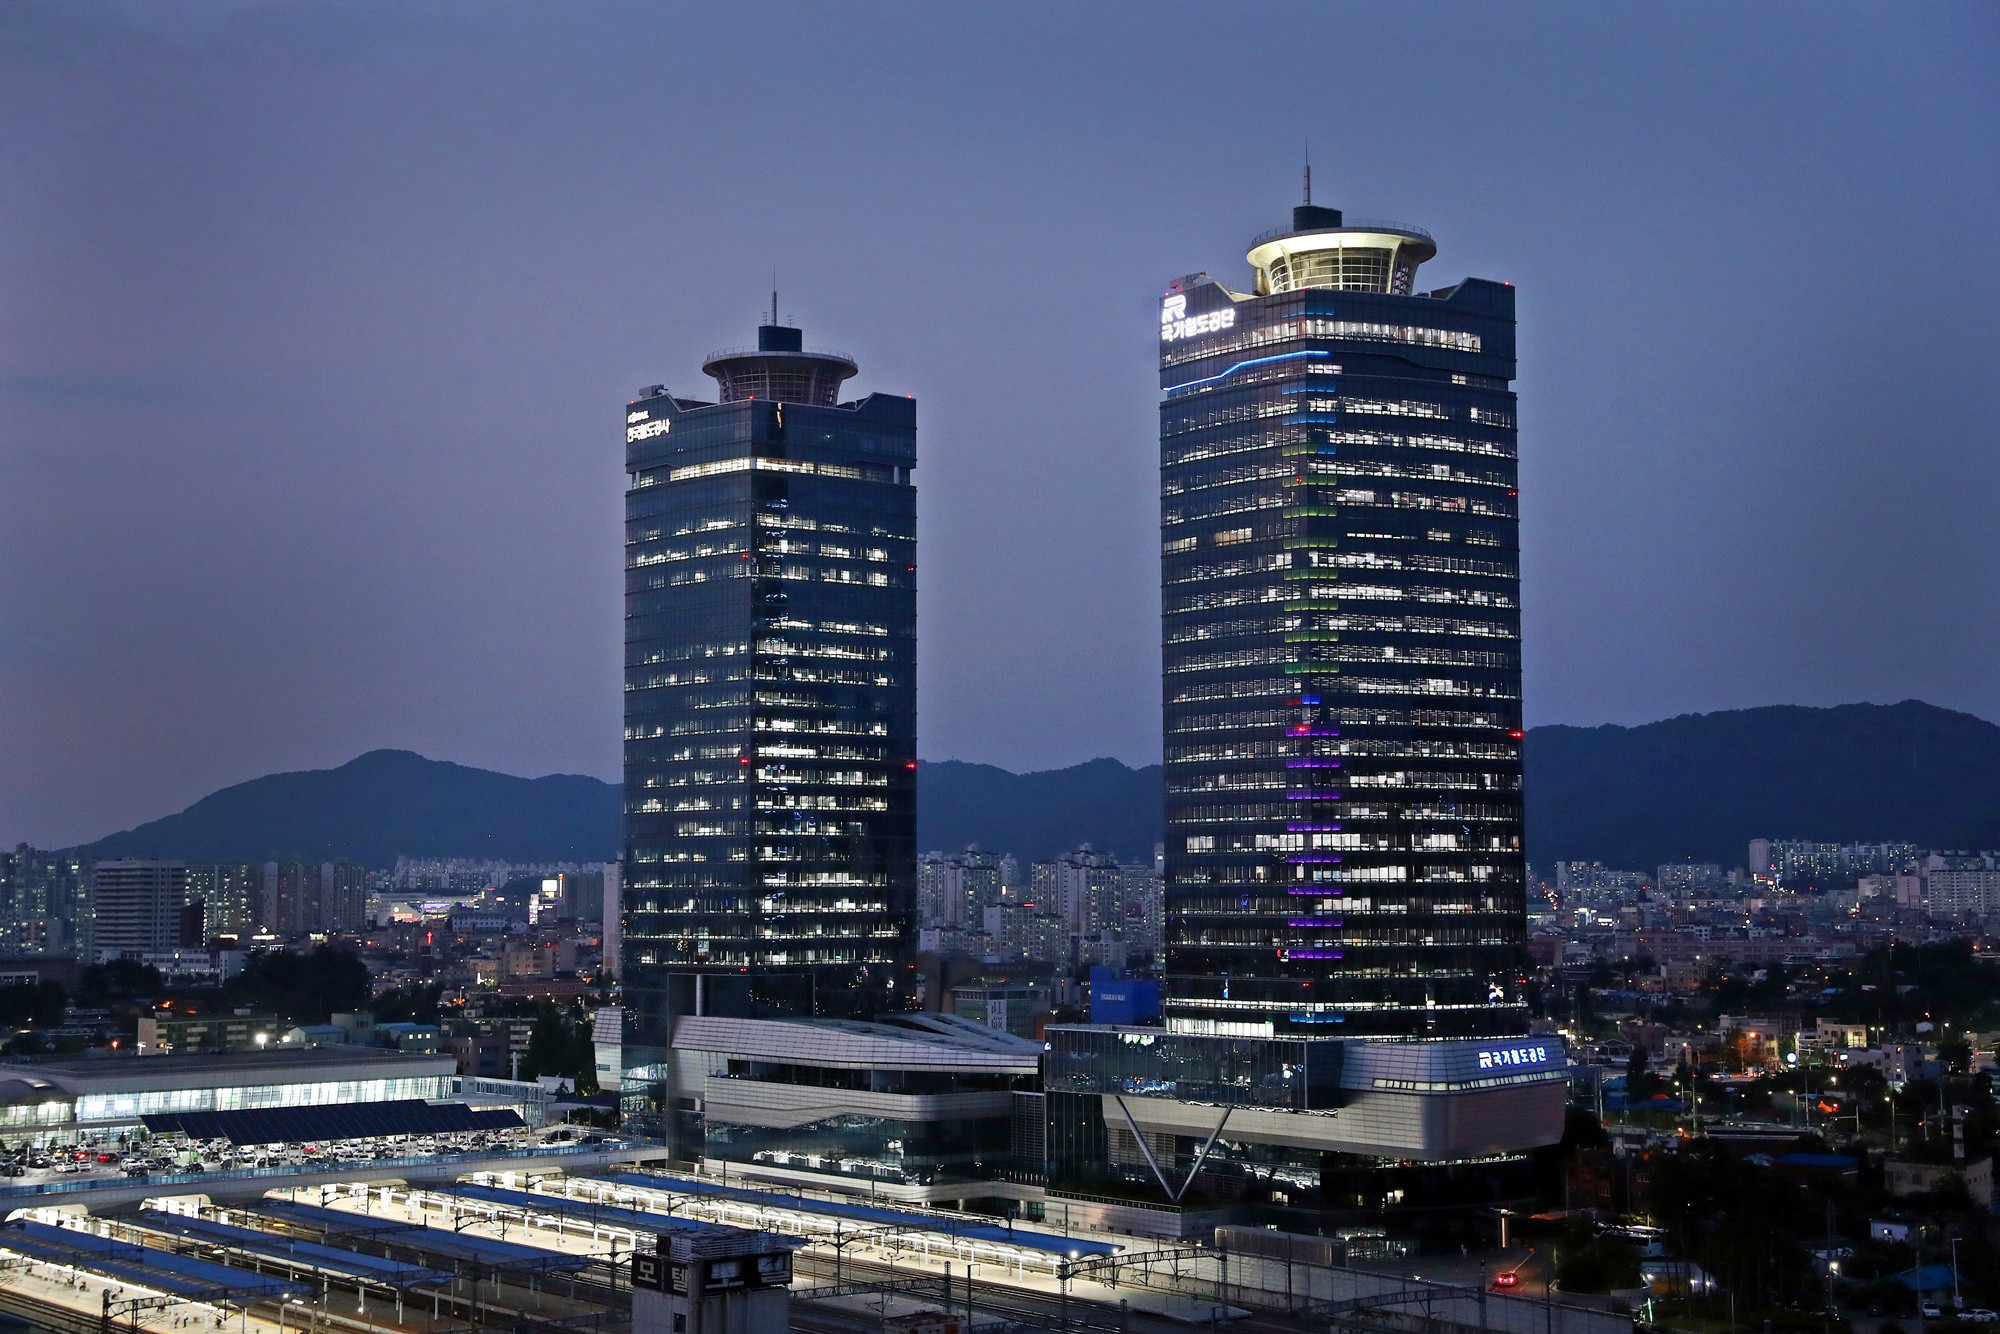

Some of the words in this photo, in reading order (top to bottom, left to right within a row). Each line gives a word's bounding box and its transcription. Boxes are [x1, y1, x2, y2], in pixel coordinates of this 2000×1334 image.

[1162, 308, 1236, 342] 국가철도공단
[1493, 1047, 1547, 1066] 국가철도공단
[638, 1261, 688, 1292] 모텔
